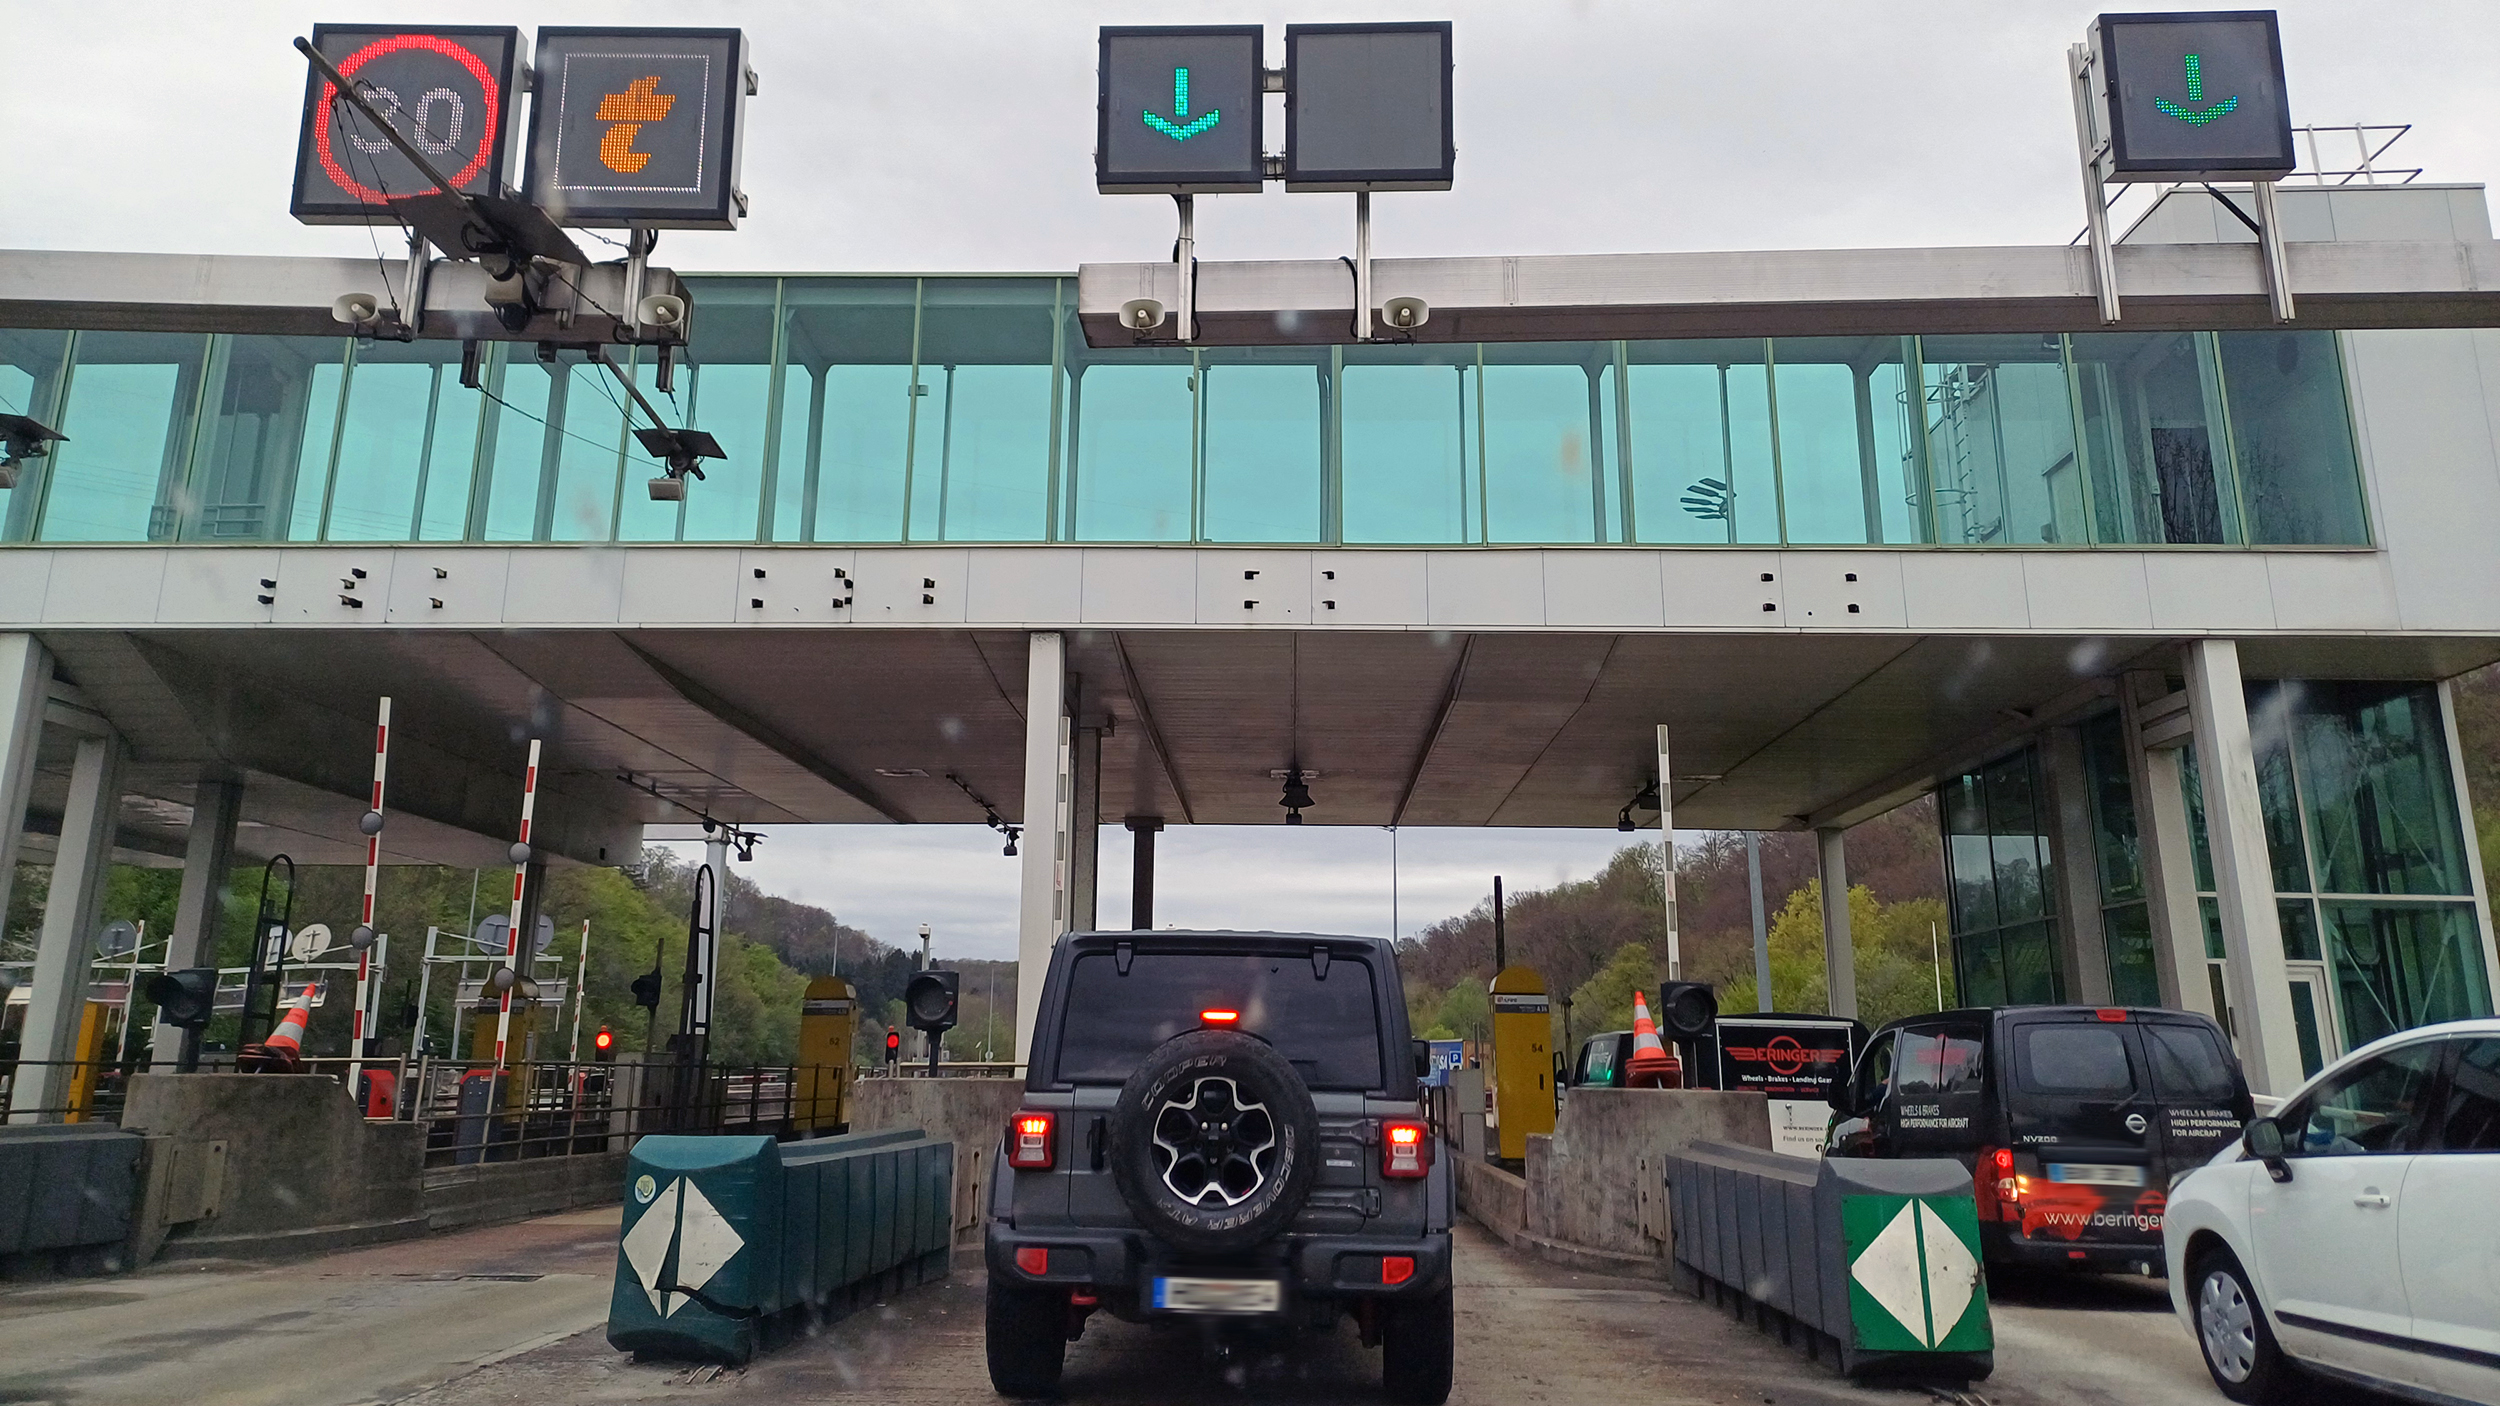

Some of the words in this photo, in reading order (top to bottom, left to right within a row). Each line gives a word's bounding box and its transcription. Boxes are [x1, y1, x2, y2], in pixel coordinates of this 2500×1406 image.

[350, 86, 464, 154] 30
[1531, 1043, 1543, 1053] 54
[1745, 1047, 1821, 1063] BERINGER
[1141, 1055, 1227, 1111] COOPER
[1741, 1074, 1764, 1082] Wheels
[1767, 1075, 1789, 1083] Brakes
[1792, 1076, 1817, 1085] Landing
[2168, 1109, 2200, 1118] WHEELS
[2206, 1110, 2233, 1118] BRAKES
[2170, 1119, 2190, 1127] HIGH
[2190, 1119, 2242, 1128] PERFORMANCE
[2172, 1129, 2188, 1137] FOR
[2188, 1129, 2222, 1138] AIRCRAFT
[2022, 1135, 2058, 1143] NV200
[1207, 1123, 1295, 1231] DISCOVERER
